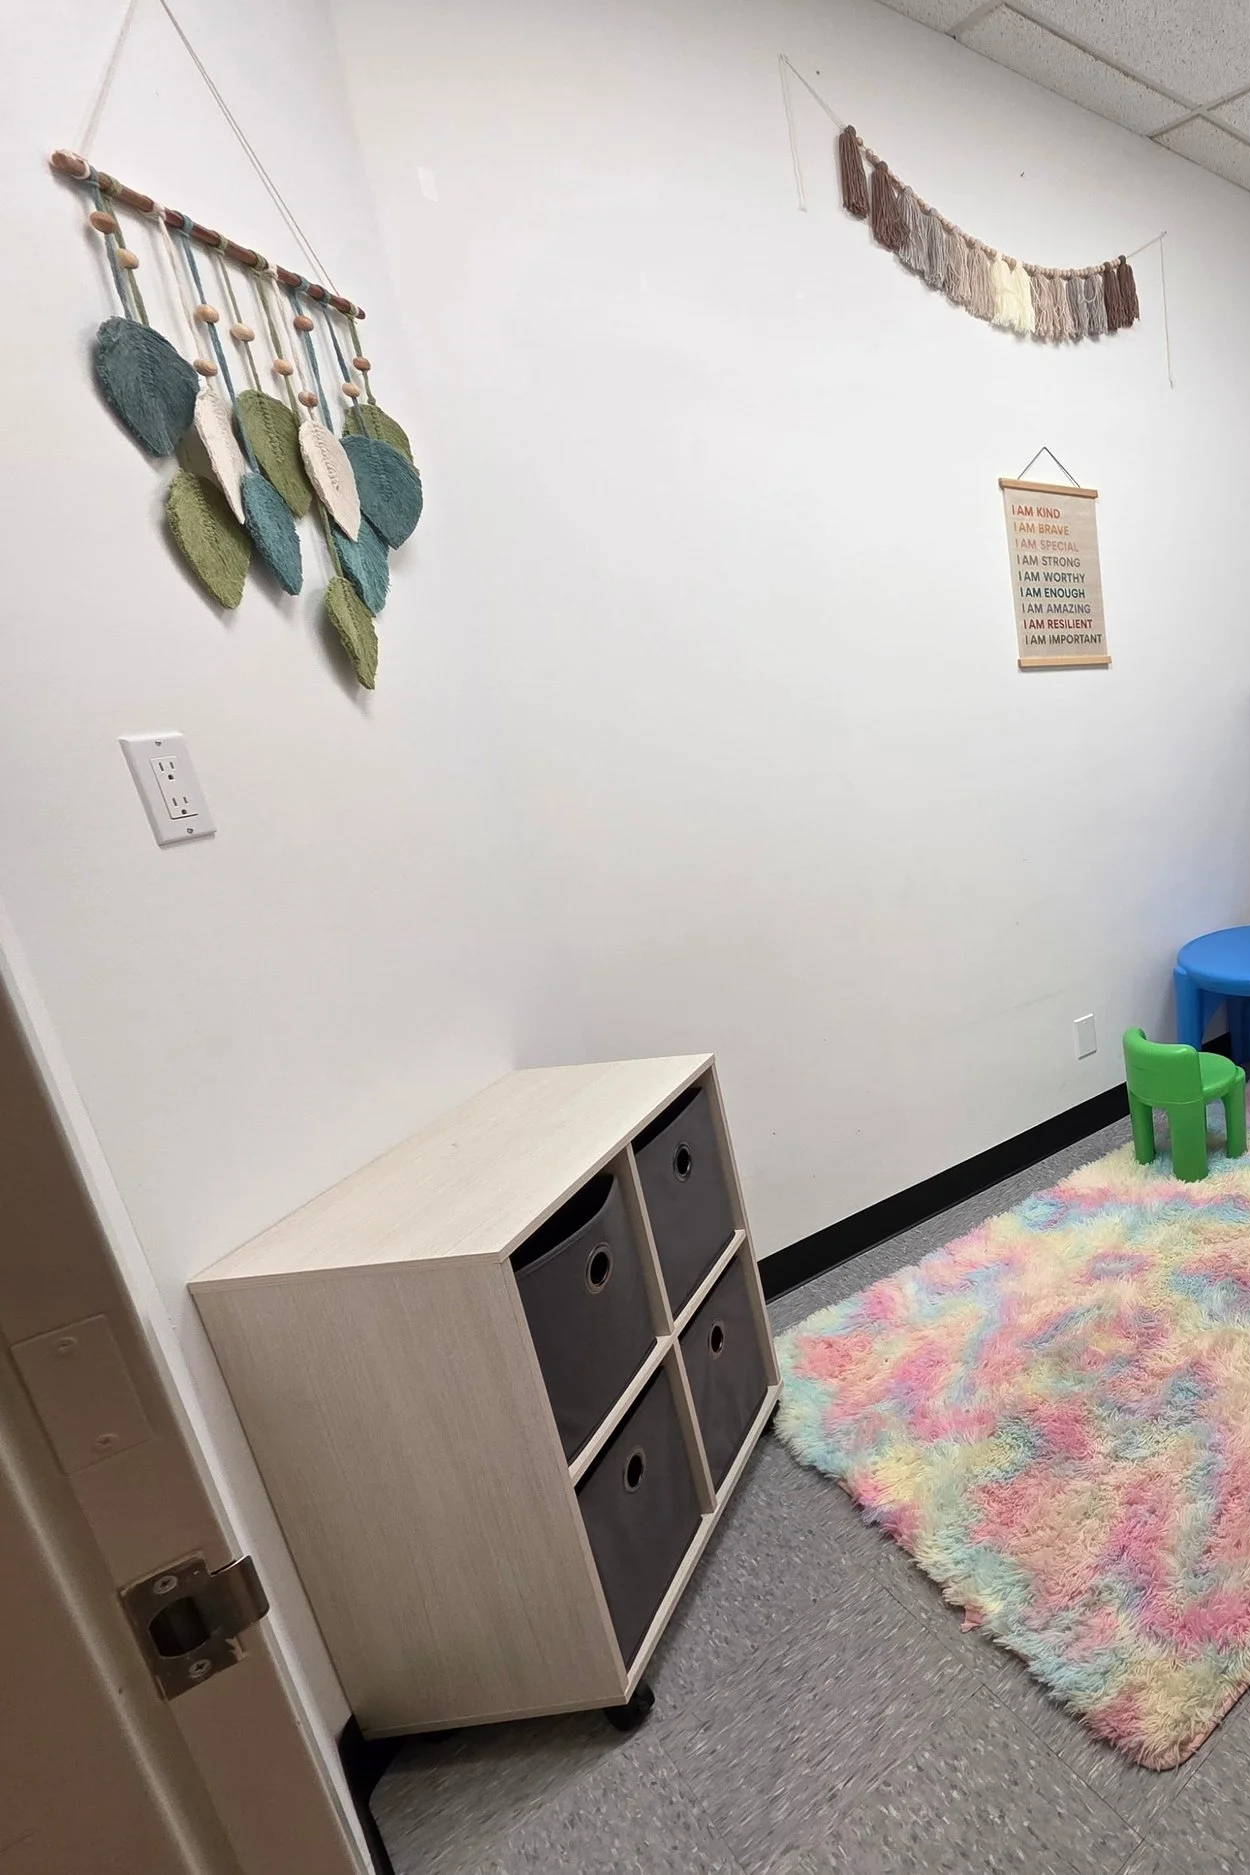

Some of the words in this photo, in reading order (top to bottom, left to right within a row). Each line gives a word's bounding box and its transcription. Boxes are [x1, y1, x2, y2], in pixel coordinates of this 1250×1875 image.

[1017, 505, 1033, 517] AM
[1036, 507, 1060, 519] KIND
[1019, 521, 1035, 533] AM
[1039, 523, 1069, 535] BRAVE
[1021, 538, 1036, 549] AM
[1040, 540, 1079, 552] SPECIAL
[1022, 555, 1038, 566] AM
[1042, 556, 1080, 567] STRONG
[1024, 571, 1040, 582] AM
[1043, 572, 1085, 584] WORTHY
[1026, 588, 1041, 597] AM
[1045, 588, 1085, 598] ENOUGH
[1027, 603, 1043, 613] AM
[1047, 603, 1091, 614] AMAZING
[1029, 619, 1045, 629] AM
[1047, 619, 1092, 629] RESILIENT
[1030, 635, 1046, 645] AM
[1049, 634, 1101, 645] IMPORTANT
